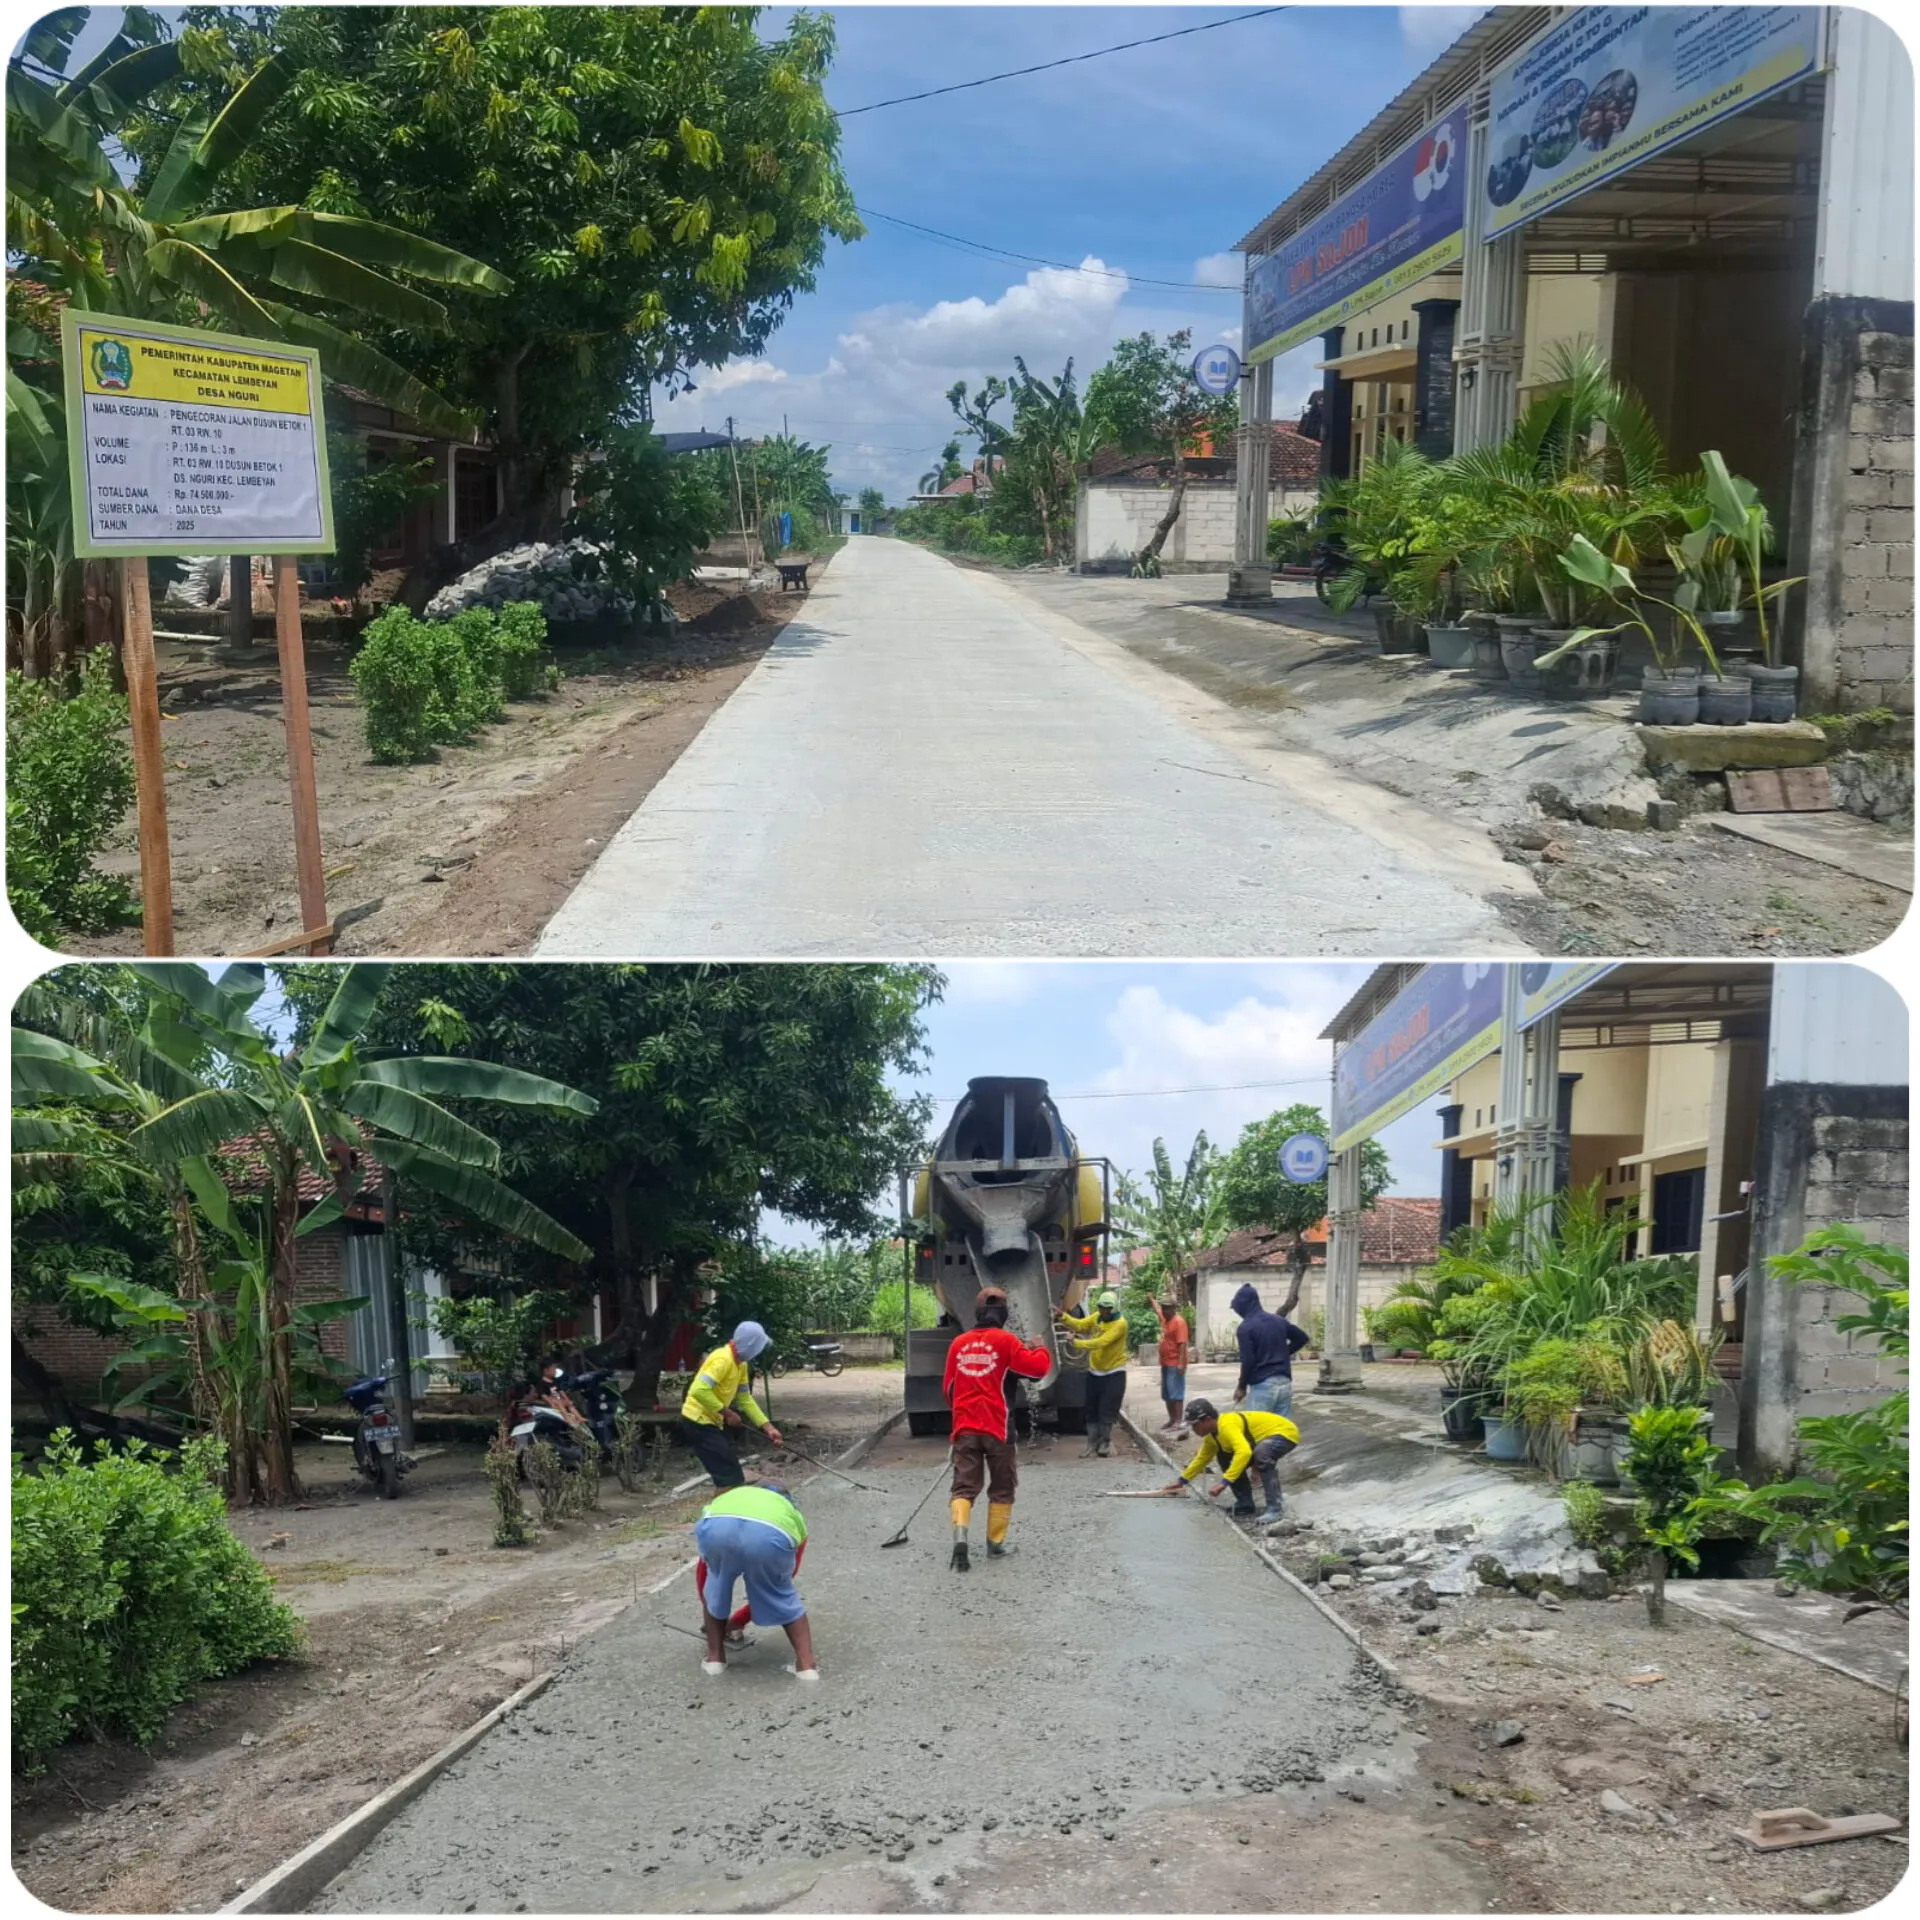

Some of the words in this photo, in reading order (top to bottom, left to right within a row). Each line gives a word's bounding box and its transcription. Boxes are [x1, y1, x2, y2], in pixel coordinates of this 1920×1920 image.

[1524, 43, 1574, 86] PROGRAM
[1586, 23, 1601, 40] TO
[1654, 104, 1708, 139] BERSAMA
[1711, 83, 1744, 108] KAMI
[140, 346, 204, 363] PEMERINTAH
[207, 354, 260, 371] KABUPATEN
[261, 363, 302, 376] MAGETAN
[173, 368, 230, 382] KECAMATAN
[232, 375, 278, 389] LEMBEYAN
[197, 387, 225, 398] DESA
[228, 391, 260, 402] NGURI
[92, 403, 118, 414] NAMA
[119, 405, 159, 418] KEGIATAN
[170, 409, 226, 424] PENGECORAN
[228, 415, 253, 426] JALAN
[253, 417, 278, 429] DUSUN
[278, 420, 301, 431] BETOK
[185, 426, 195, 437] 03
[94, 436, 131, 448] VOLUME
[185, 443, 199, 453] 136
[95, 453, 127, 464] LOKASI
[187, 458, 197, 468] 03
[225, 460, 252, 470] DUSUN
[253, 462, 277, 471] BETOK
[189, 473, 216, 484] NGURI
[236, 476, 276, 486] LEMBEYAN
[97, 486, 124, 497] TOTAL
[125, 487, 149, 498] DANA
[98, 503, 133, 513] SUMBER
[135, 504, 159, 514] DANA
[175, 504, 200, 515] DANA
[200, 504, 222, 515] DESA
[99, 519, 128, 530] TAHUN
[176, 520, 195, 530] 2025
